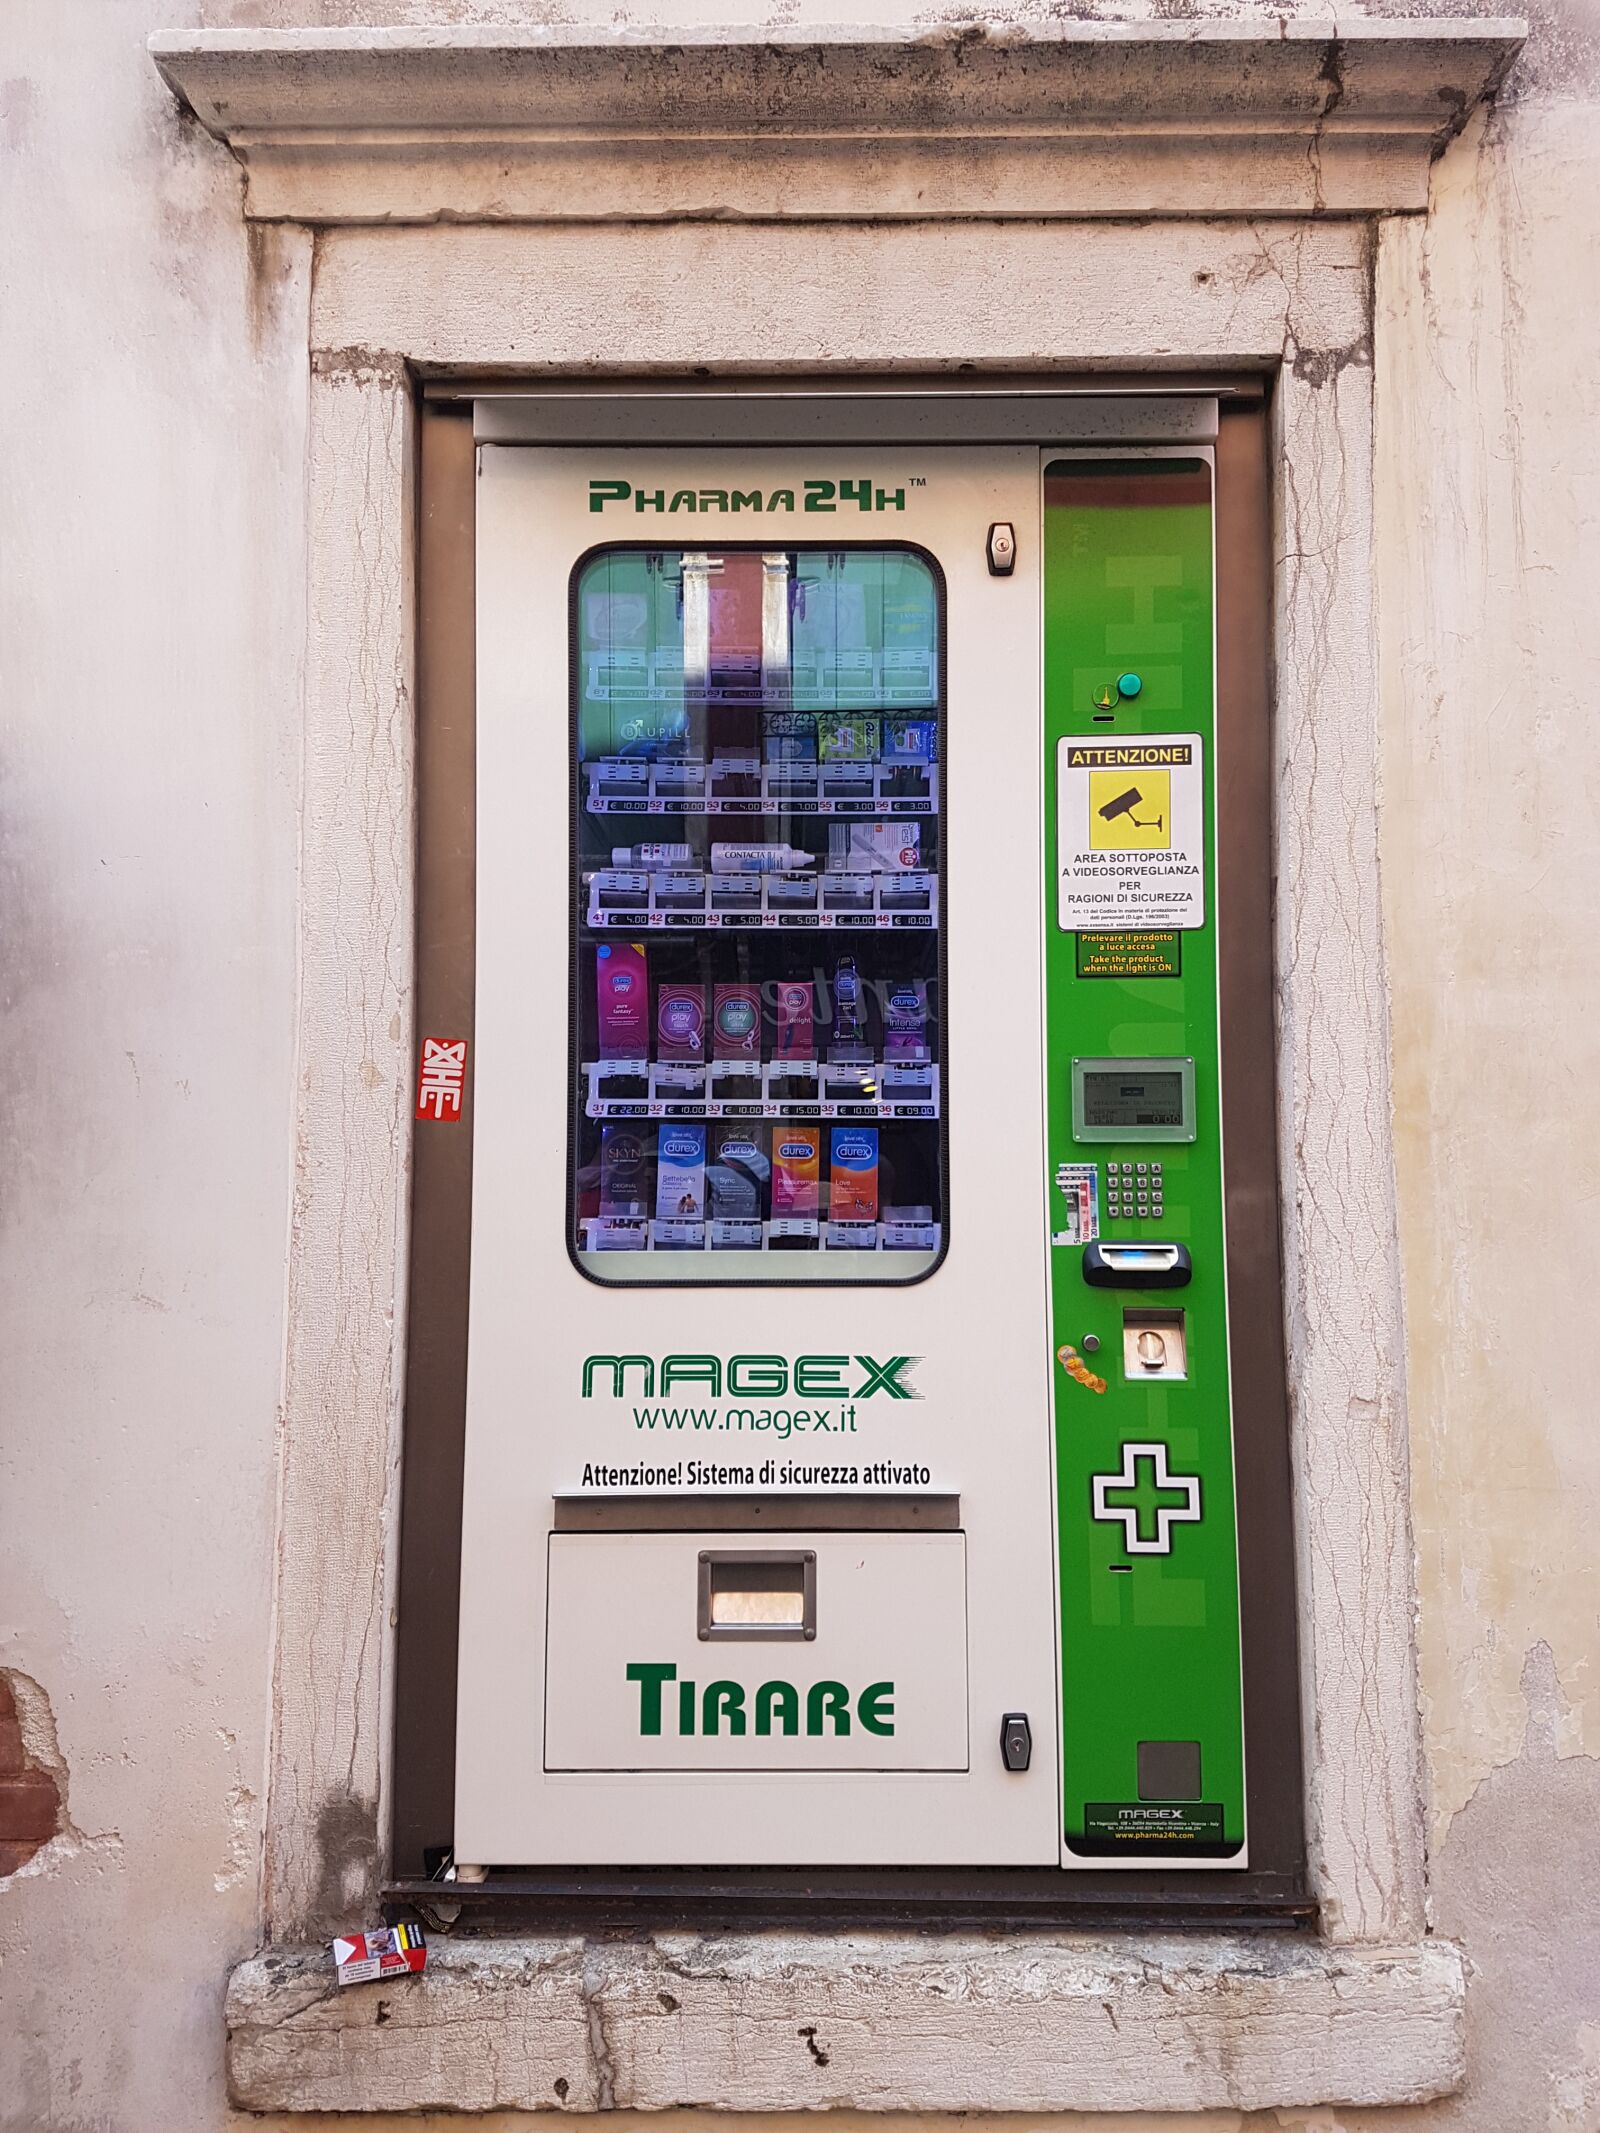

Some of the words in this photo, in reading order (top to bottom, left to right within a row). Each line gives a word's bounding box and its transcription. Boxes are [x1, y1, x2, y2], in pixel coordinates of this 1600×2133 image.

[865, 721, 875, 755] Ricola
[1071, 748, 1189, 764] ATTENZIONE!
[1074, 854, 1106, 863] AREA
[1109, 852, 1187, 863] SOTTOPOSTA
[1062, 868, 1070, 877] A
[1073, 865, 1200, 876] VIDEOSORVEGLIANZA
[1119, 881, 1141, 890] PER
[1068, 894, 1114, 903] RAGIONI
[1117, 894, 1128, 902] DI
[1130, 892, 1193, 902] SICUREZZA
[1082, 934, 1123, 942] Prelevare
[1125, 934, 1131, 942] il
[1133, 933, 1173, 944] prodotto
[1107, 942, 1125, 951] luce
[1127, 943, 1156, 951] accesa
[1090, 955, 1109, 963] Take
[1111, 955, 1126, 963] the
[1128, 955, 1163, 965] product
[1083, 964, 1107, 972] when
[1109, 964, 1124, 972] the
[1126, 963, 1147, 974] light
[1149, 964, 1156, 972] is
[893, 998, 917, 1006] durex
[671, 1013, 691, 1022] play
[727, 1013, 747, 1022] play
[667, 1143, 697, 1153] durex
[723, 1145, 754, 1154] durex
[782, 1146, 811, 1155] durex
[840, 1147, 869, 1156] durex
[608, 1148, 640, 1159] SKYN
[1091, 1228, 1097, 1237] 20
[582, 1354, 926, 1400] MAGEX
[633, 1404, 858, 1440] www.magex.it
[581, 1462, 682, 1487] Attenzione!
[687, 1461, 754, 1485] Sistema
[759, 1460, 775, 1484] di
[779, 1461, 858, 1485] sicurezza
[863, 1461, 931, 1485] attivato
[626, 1663, 895, 1736] TIRARE
[1118, 1809, 1184, 1819] MAGEX
[1115, 1831, 1195, 1840] www.pharma24h.com
